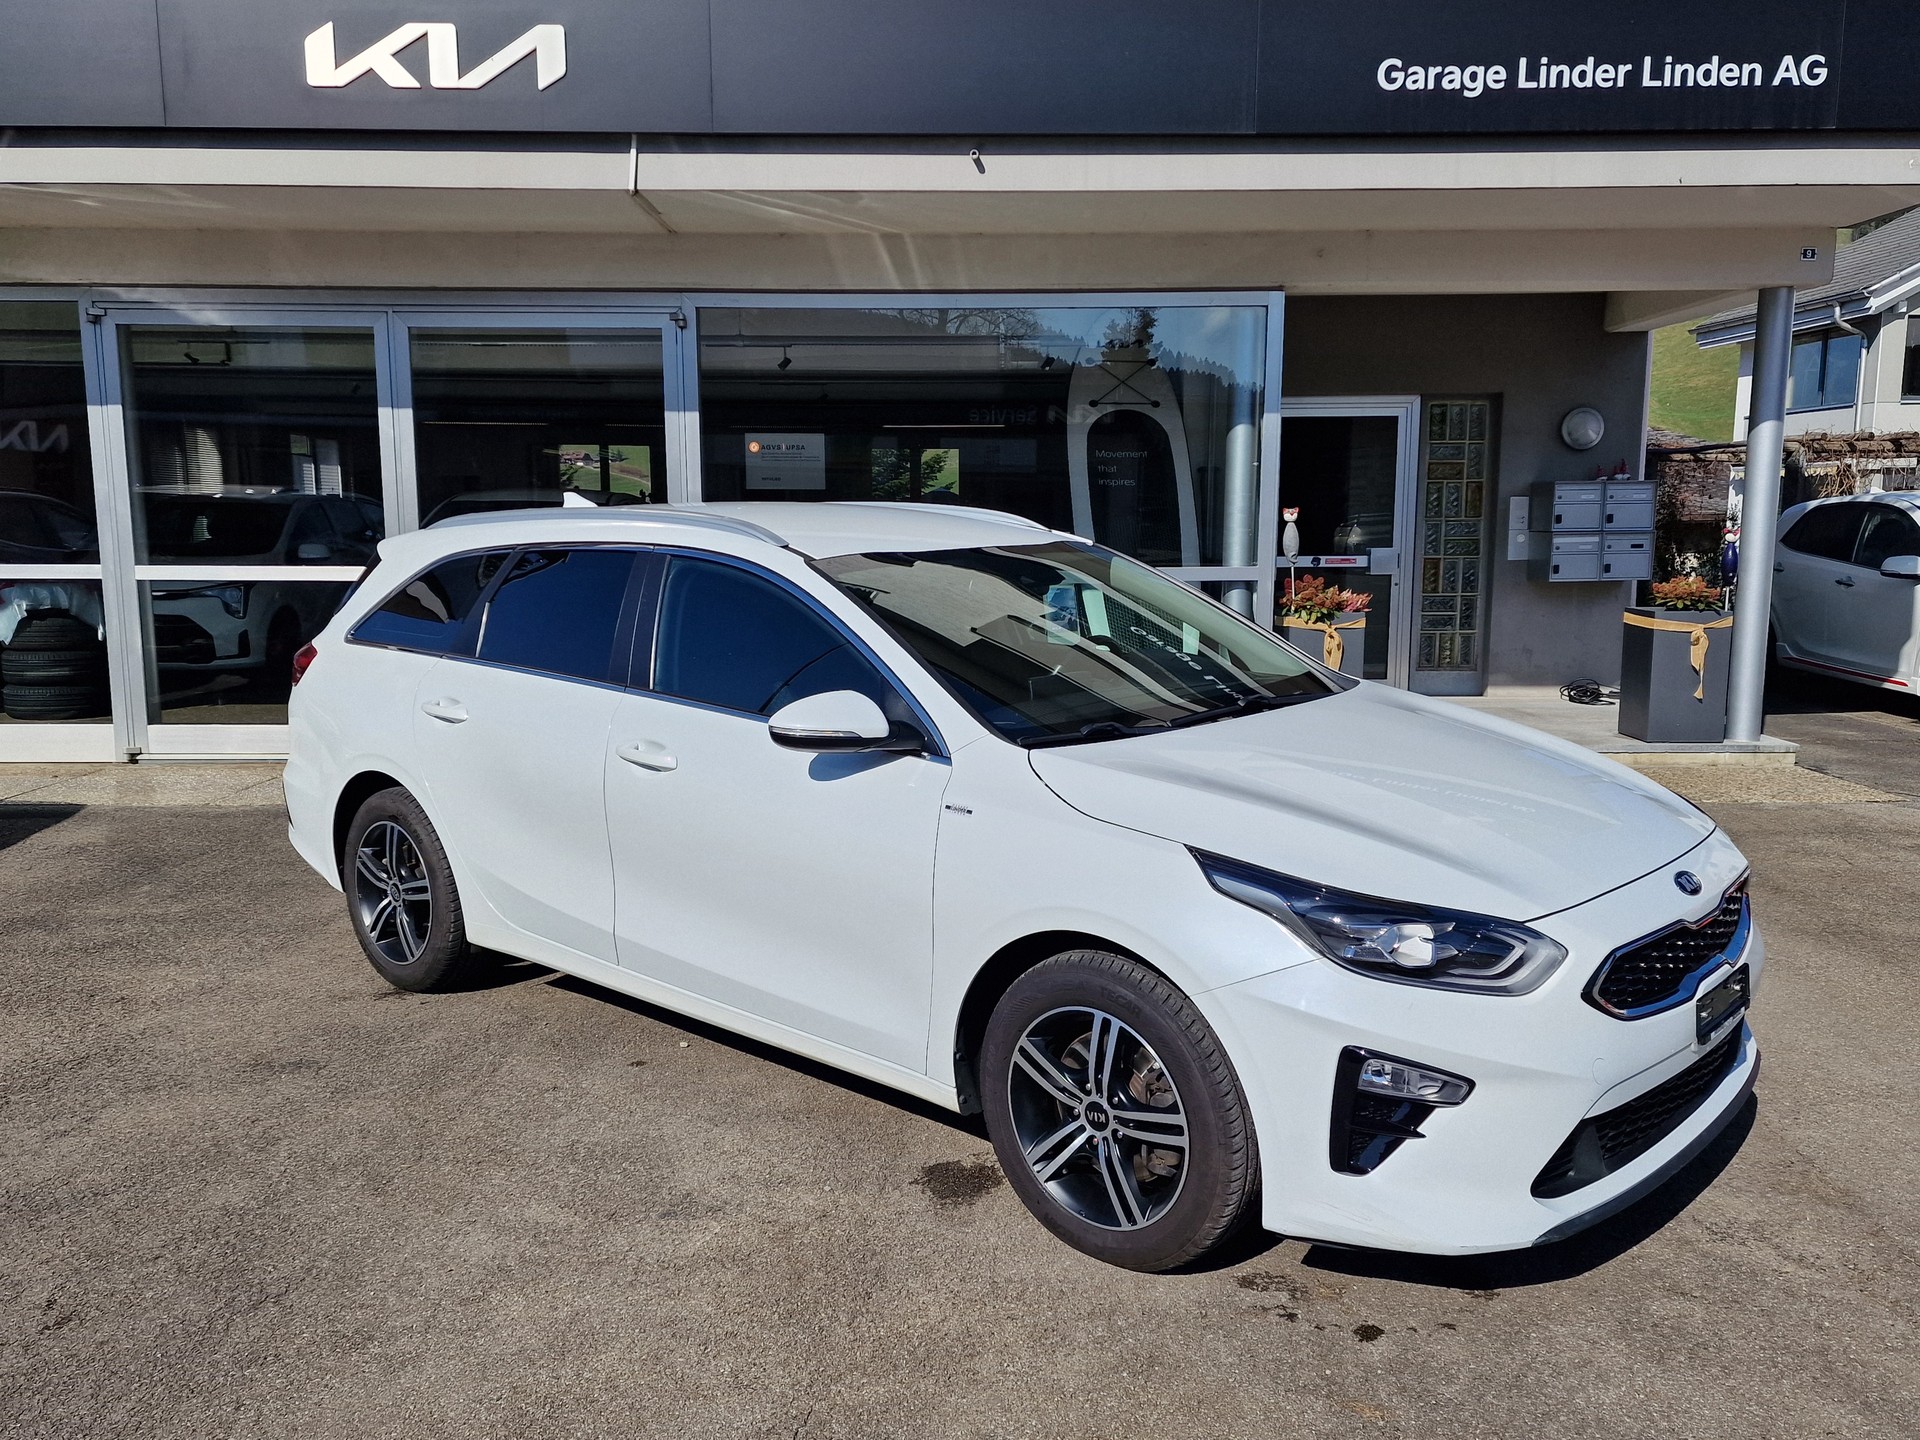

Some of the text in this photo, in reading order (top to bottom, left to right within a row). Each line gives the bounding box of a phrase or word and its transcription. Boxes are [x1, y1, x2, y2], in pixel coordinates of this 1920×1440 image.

[304, 21, 567, 91] KIA
[1376, 53, 1829, 98] Garage Linder Linden AG
[1806, 249, 1812, 258] 9
[1095, 449, 1148, 459] Movement
[1097, 464, 1117, 473] that
[1098, 477, 1136, 487] inspires
[1086, 1109, 1107, 1124] KIA
